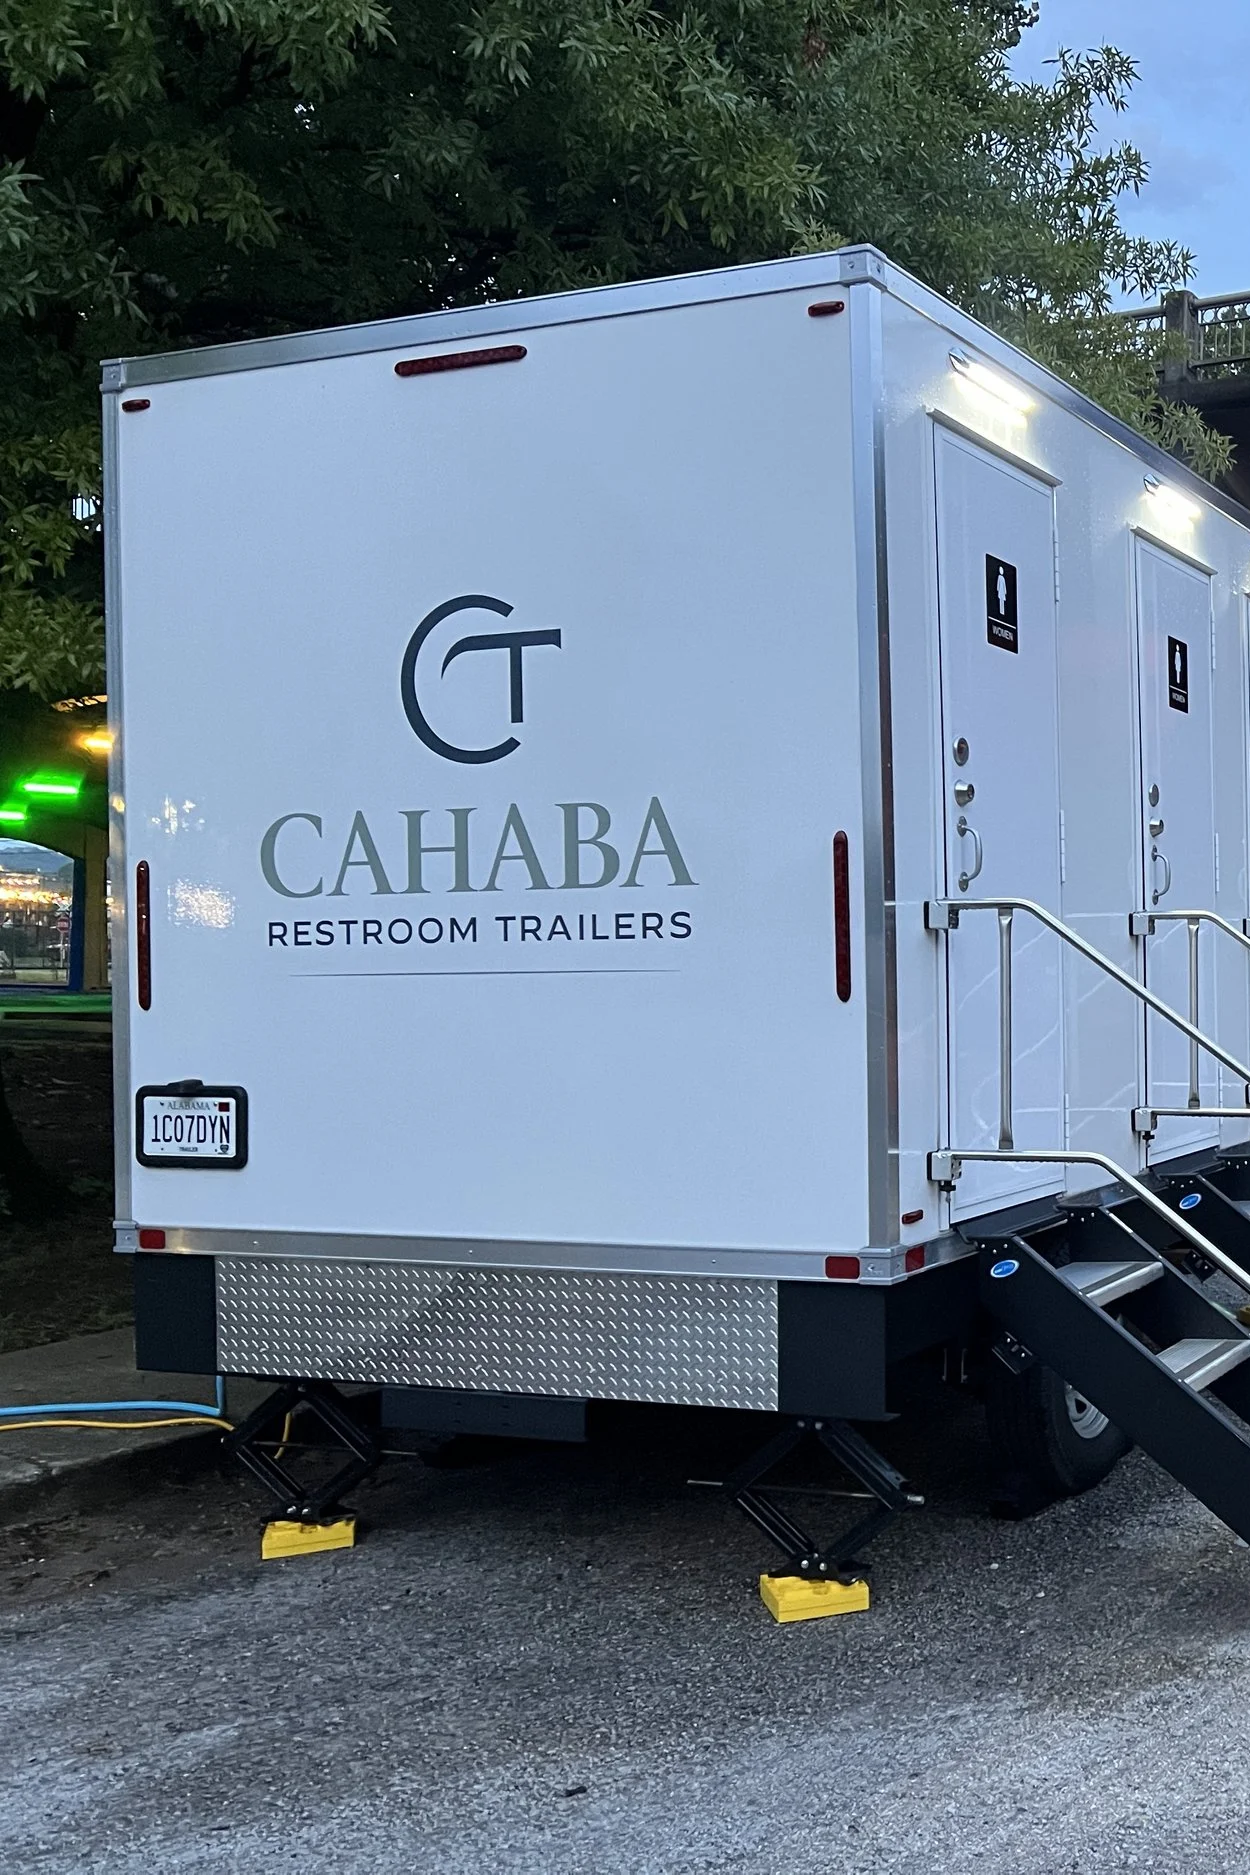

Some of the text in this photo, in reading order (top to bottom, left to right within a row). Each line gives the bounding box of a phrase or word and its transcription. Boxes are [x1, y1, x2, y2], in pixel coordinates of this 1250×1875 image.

[992, 624, 1014, 641] WOMEN
[259, 796, 700, 899] CAHABA
[267, 911, 693, 947] RESTROOM TRAILERS
[166, 1101, 210, 1110] ALABAMA
[151, 1115, 230, 1143] 1C07DYN
